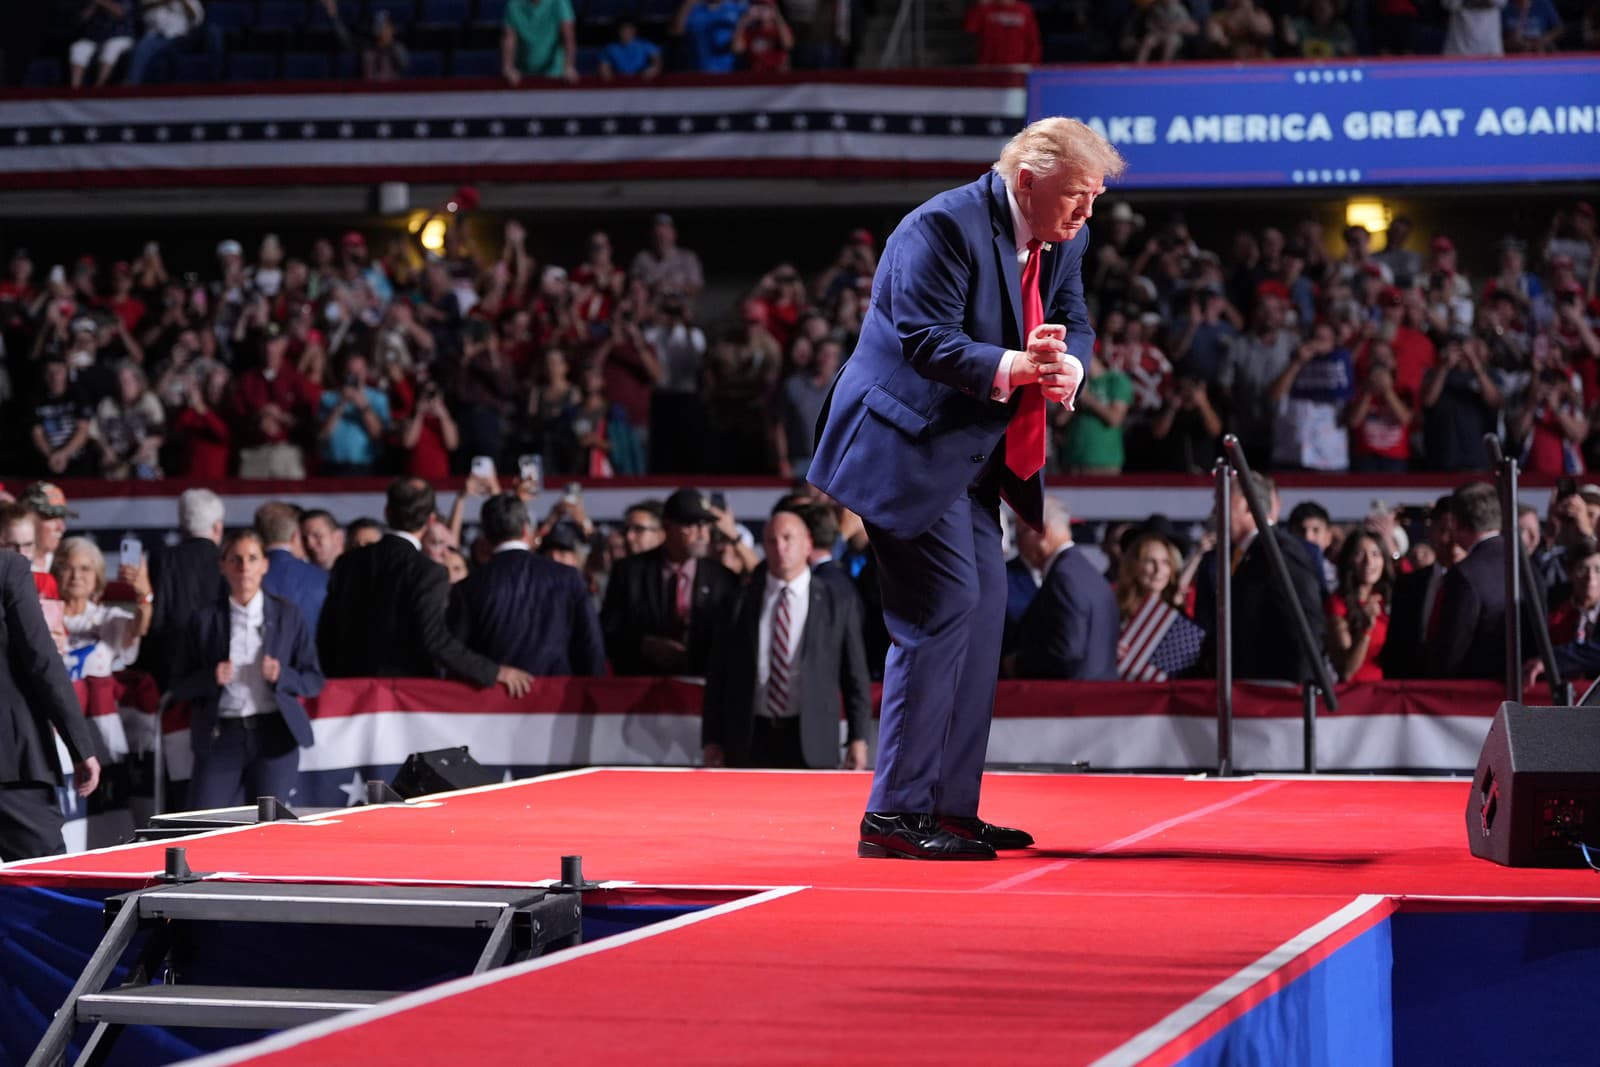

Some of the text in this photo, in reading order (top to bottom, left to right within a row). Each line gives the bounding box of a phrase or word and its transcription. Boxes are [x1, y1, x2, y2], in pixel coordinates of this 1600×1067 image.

[1073, 116, 1156, 144] AKE
[1166, 113, 1333, 144] AMERICA
[1343, 109, 1465, 140] GREAT
